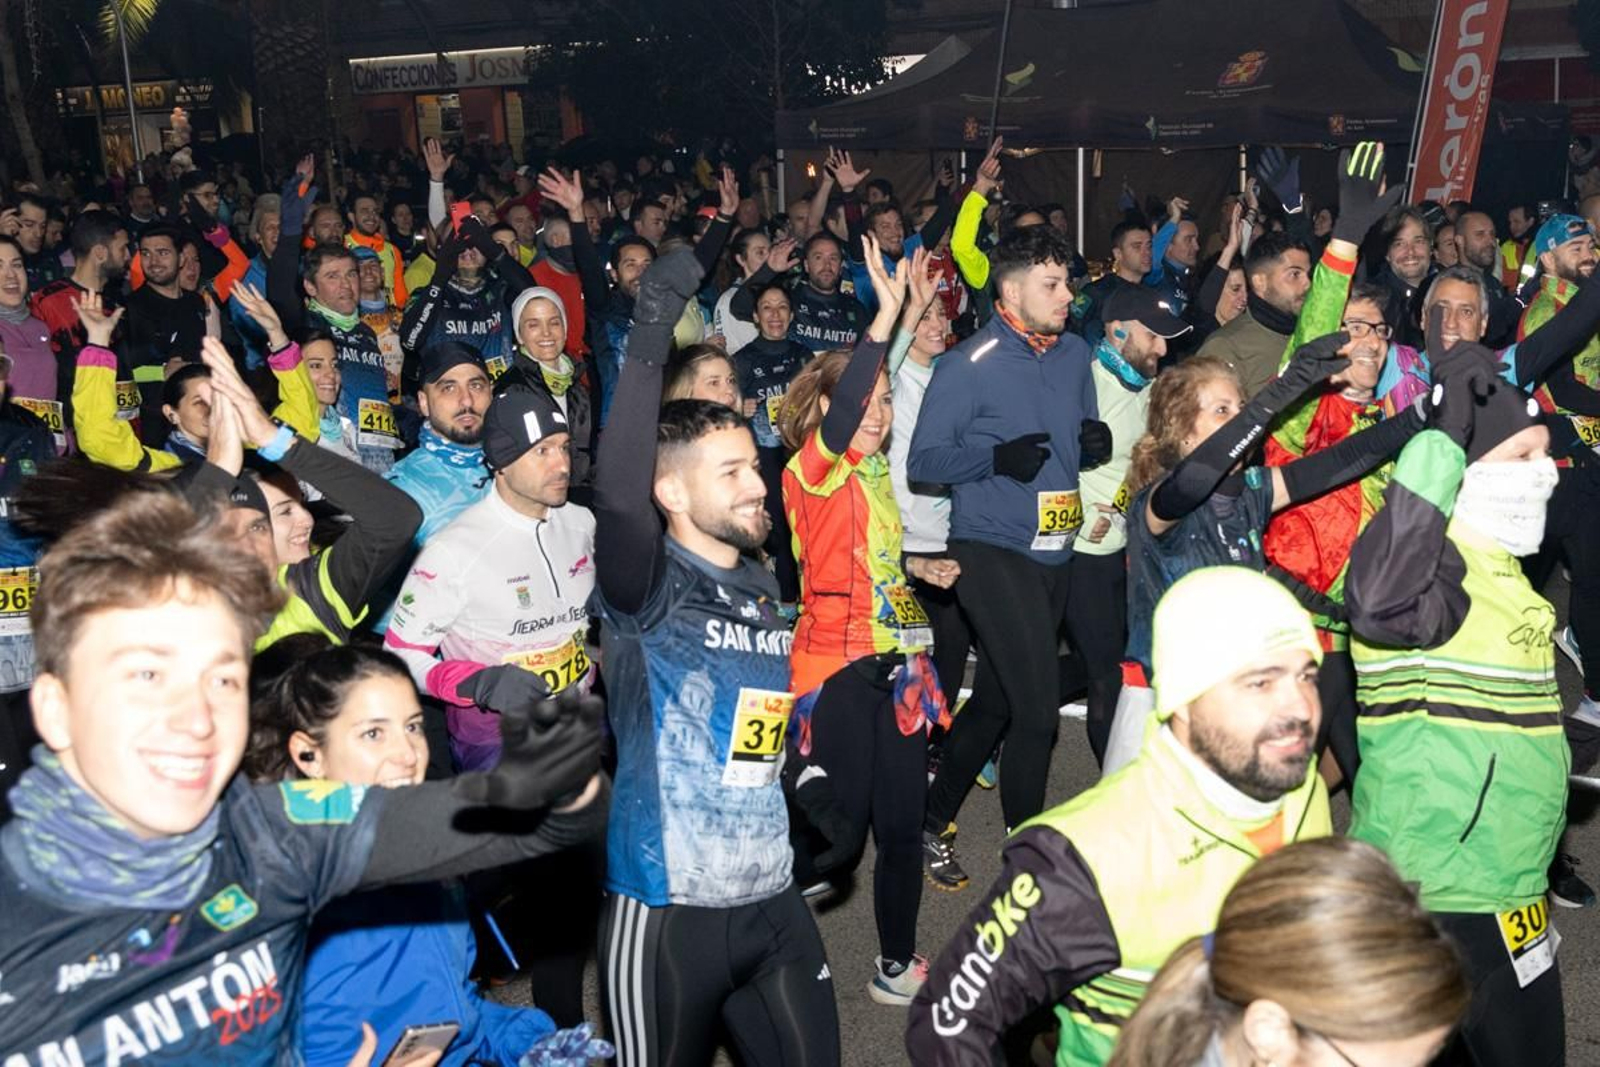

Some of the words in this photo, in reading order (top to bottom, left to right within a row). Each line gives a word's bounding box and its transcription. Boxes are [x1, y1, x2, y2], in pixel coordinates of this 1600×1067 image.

[445, 320, 467, 334] SAN
[797, 323, 822, 338] SAN
[757, 384, 783, 401] SAN
[508, 616, 555, 637] SIERRA
[703, 618, 752, 652] SAN
[103, 941, 278, 1067] ANTÓN
